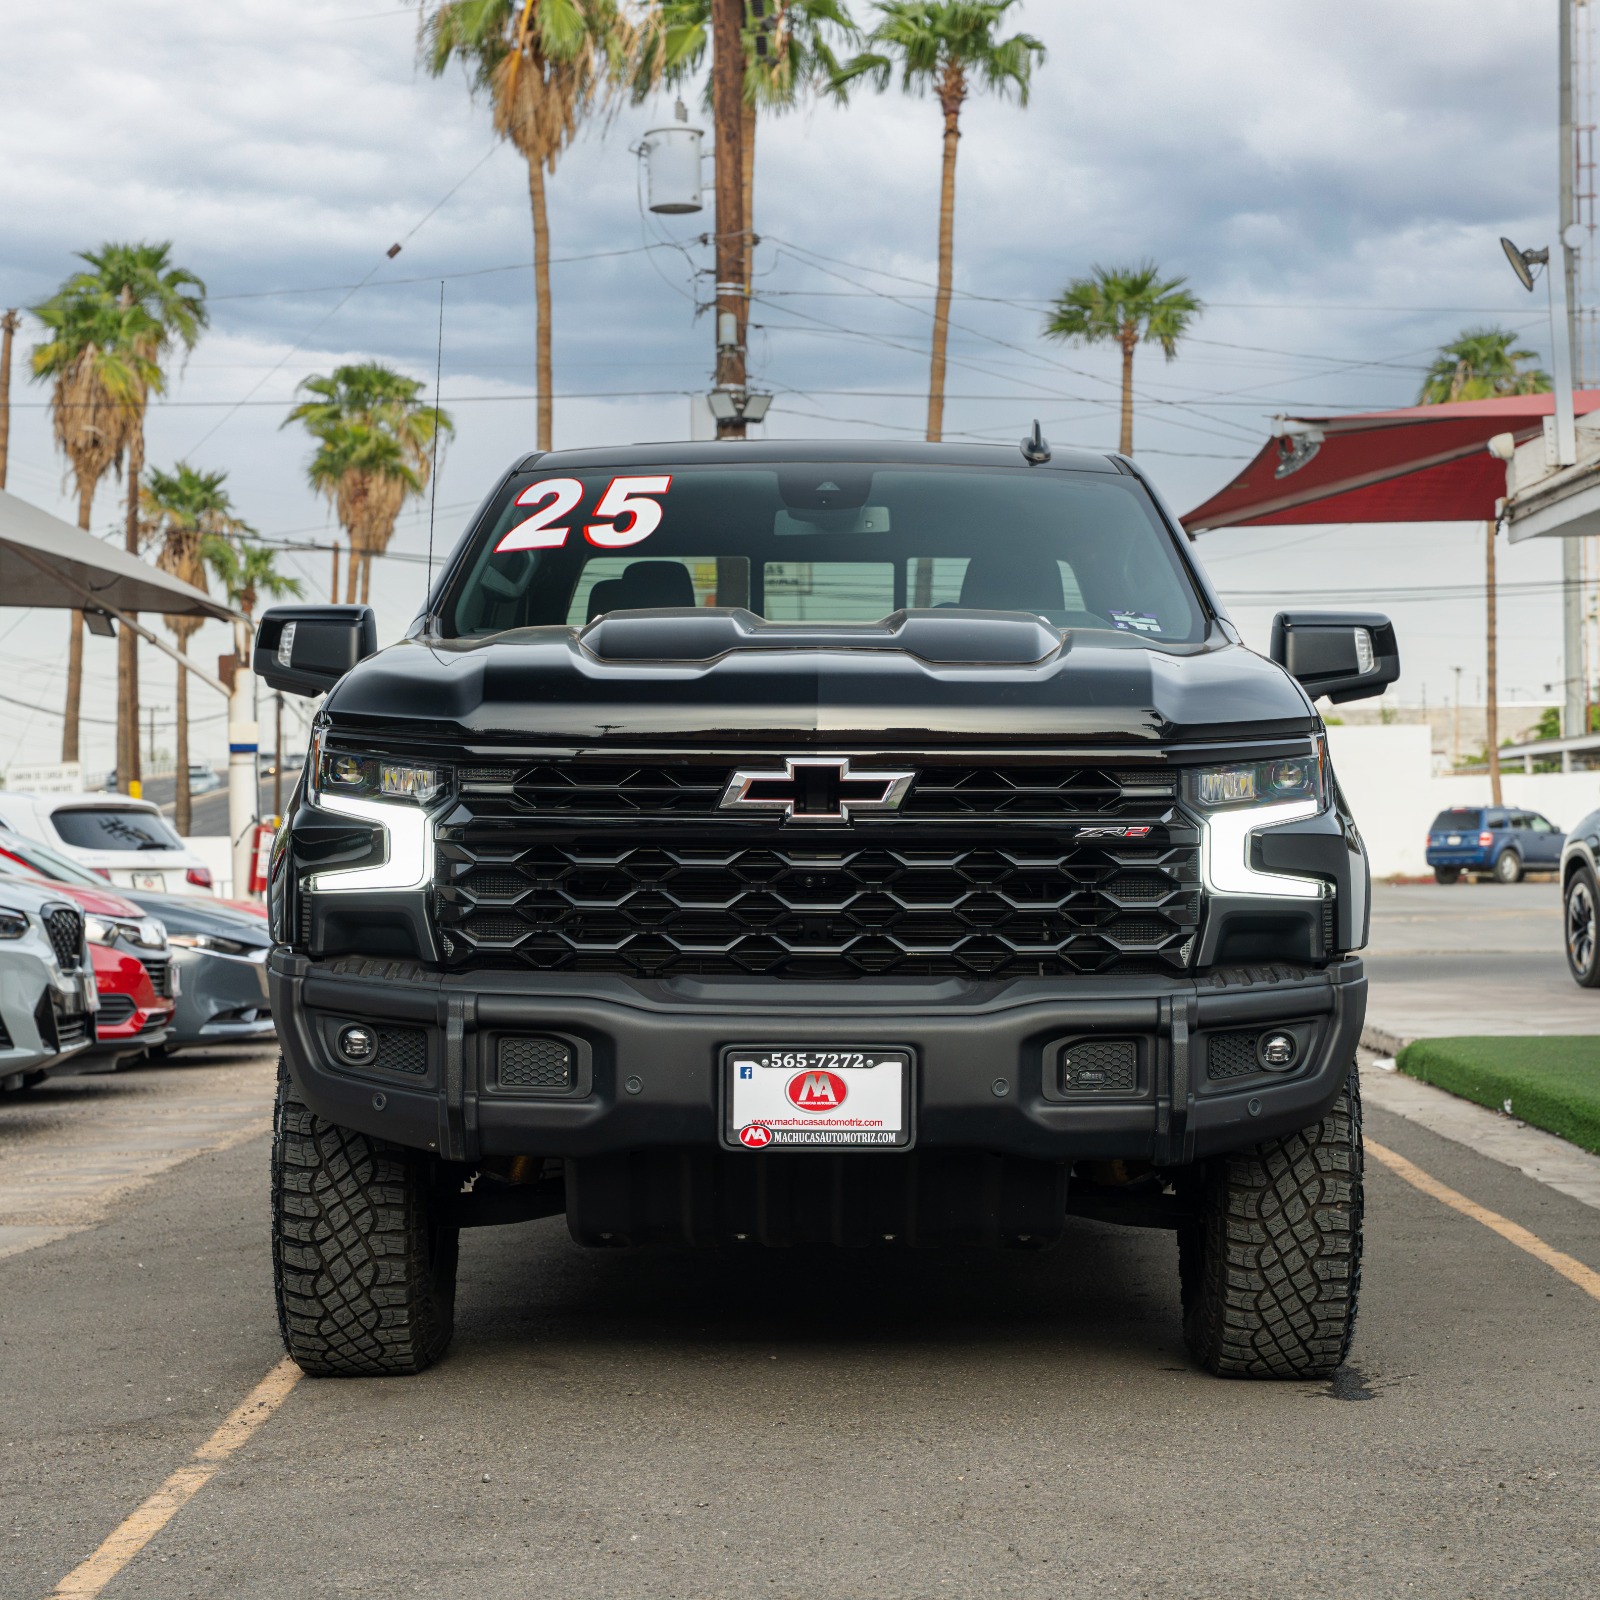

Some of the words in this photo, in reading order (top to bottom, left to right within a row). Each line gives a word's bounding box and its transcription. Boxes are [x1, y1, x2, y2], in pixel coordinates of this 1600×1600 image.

[493, 475, 672, 553] 25
[1074, 826, 1153, 838] ZR2
[770, 1053, 864, 1068] 565-7272
[751, 1118, 883, 1127] www.machucasautomotriz.com
